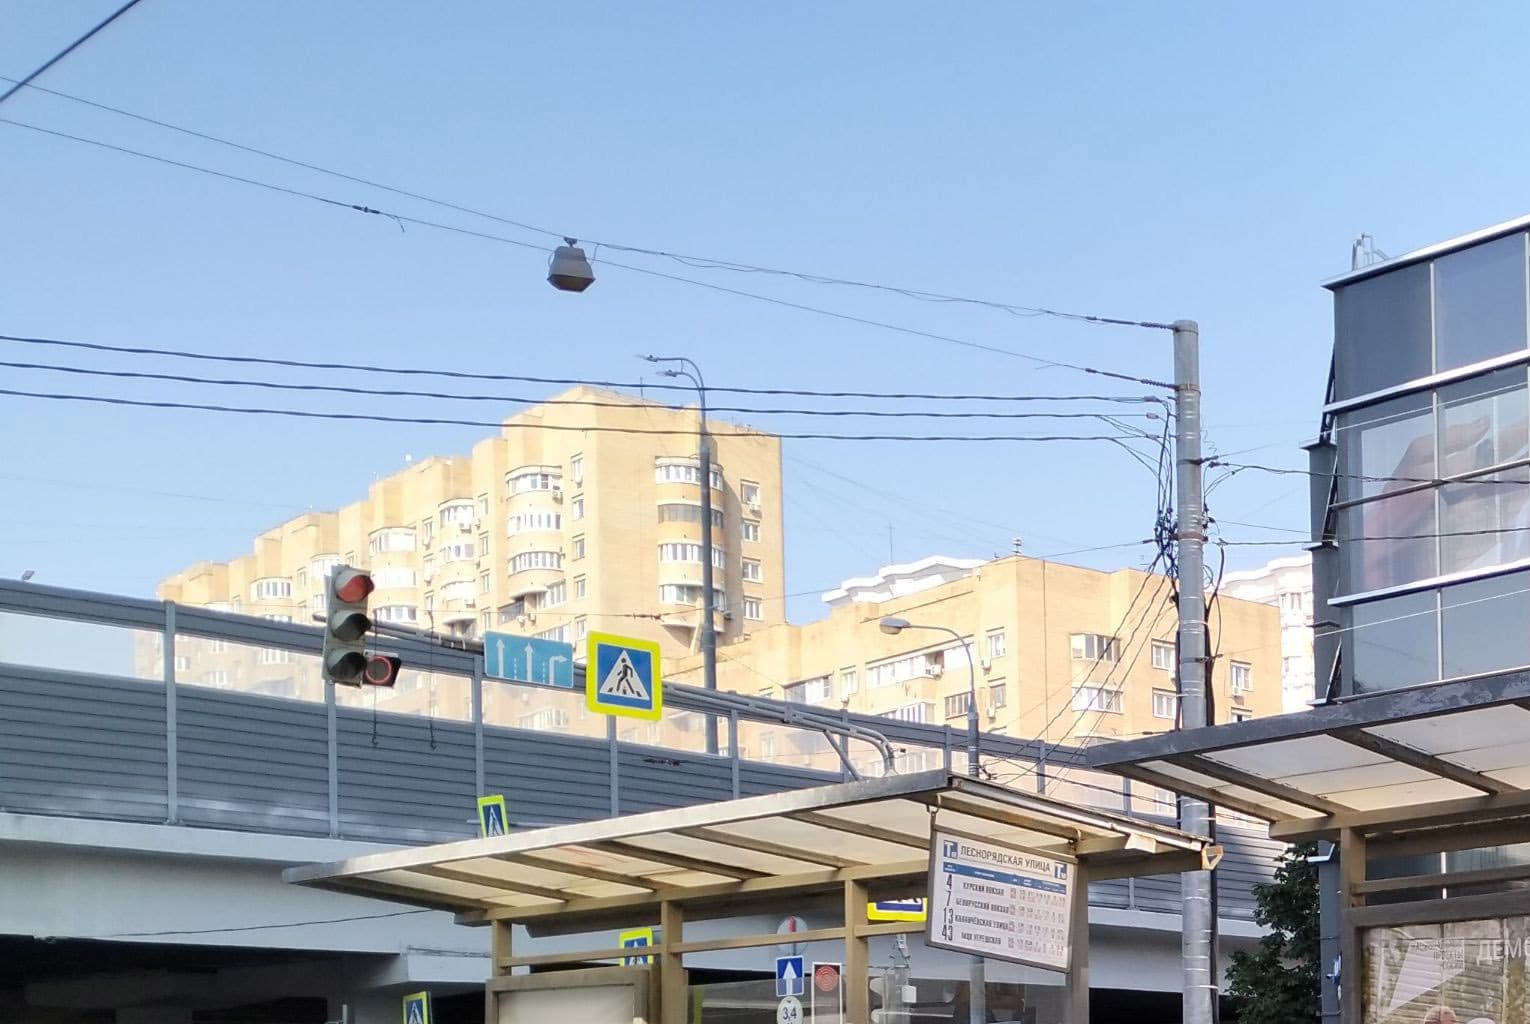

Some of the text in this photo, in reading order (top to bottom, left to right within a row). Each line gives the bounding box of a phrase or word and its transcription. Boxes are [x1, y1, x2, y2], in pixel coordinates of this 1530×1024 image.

[960, 845, 1024, 866] ЛЕСНОРЯДСКАЯ
[1024, 858, 1051, 873] УЛИЦА
[946, 874, 952, 891] 4
[945, 890, 952, 906] 7
[943, 907, 954, 924] 13
[941, 924, 953, 941] 43
[782, 1005, 797, 1022] 3,4
